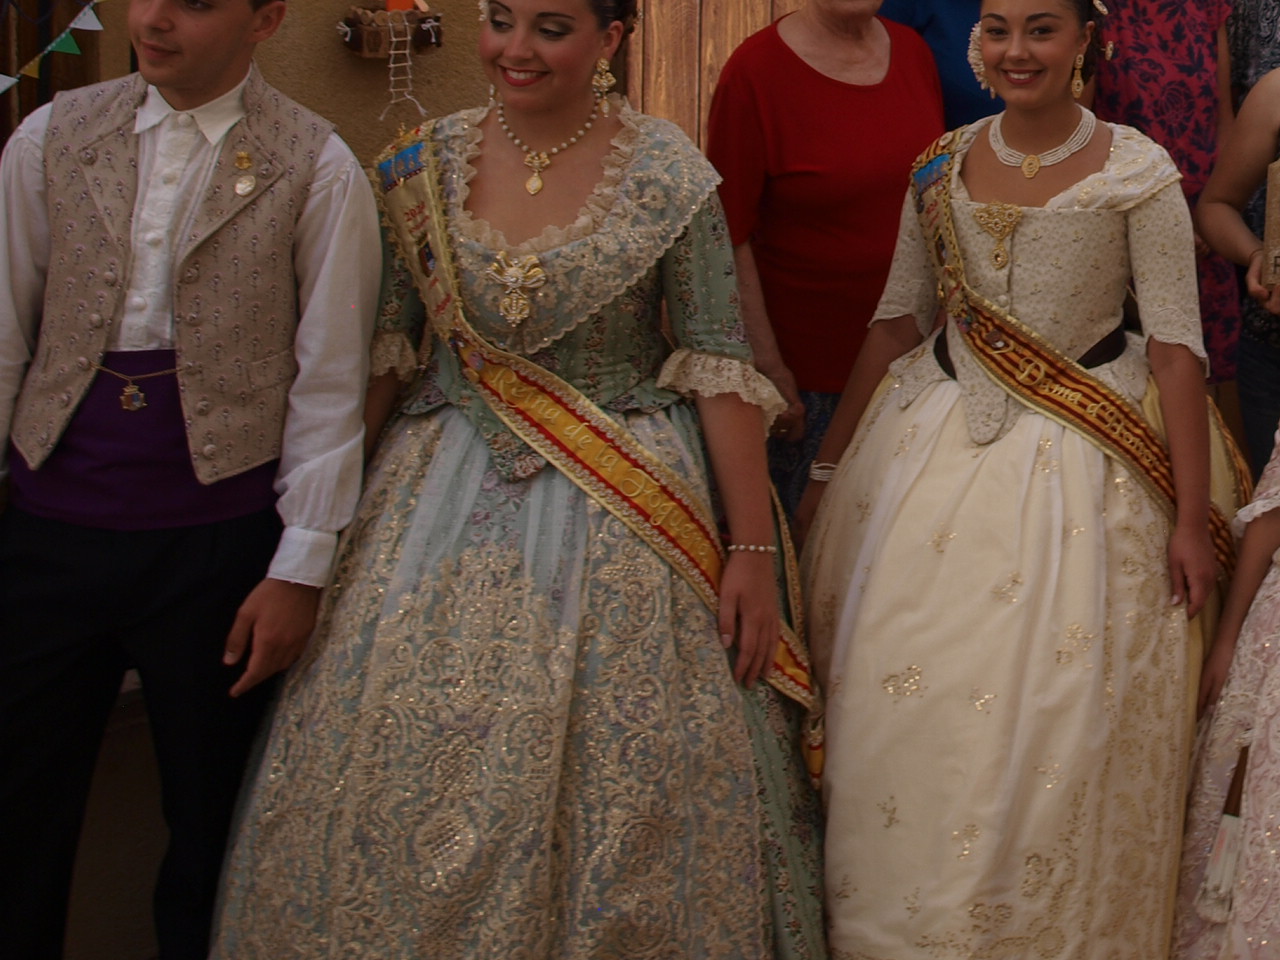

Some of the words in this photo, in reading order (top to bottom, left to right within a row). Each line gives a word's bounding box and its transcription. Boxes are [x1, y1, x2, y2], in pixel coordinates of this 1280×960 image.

[1016, 357, 1082, 403] Dama
[490, 366, 562, 425] Reina
[563, 421, 592, 448] de
[594, 442, 620, 474] la
